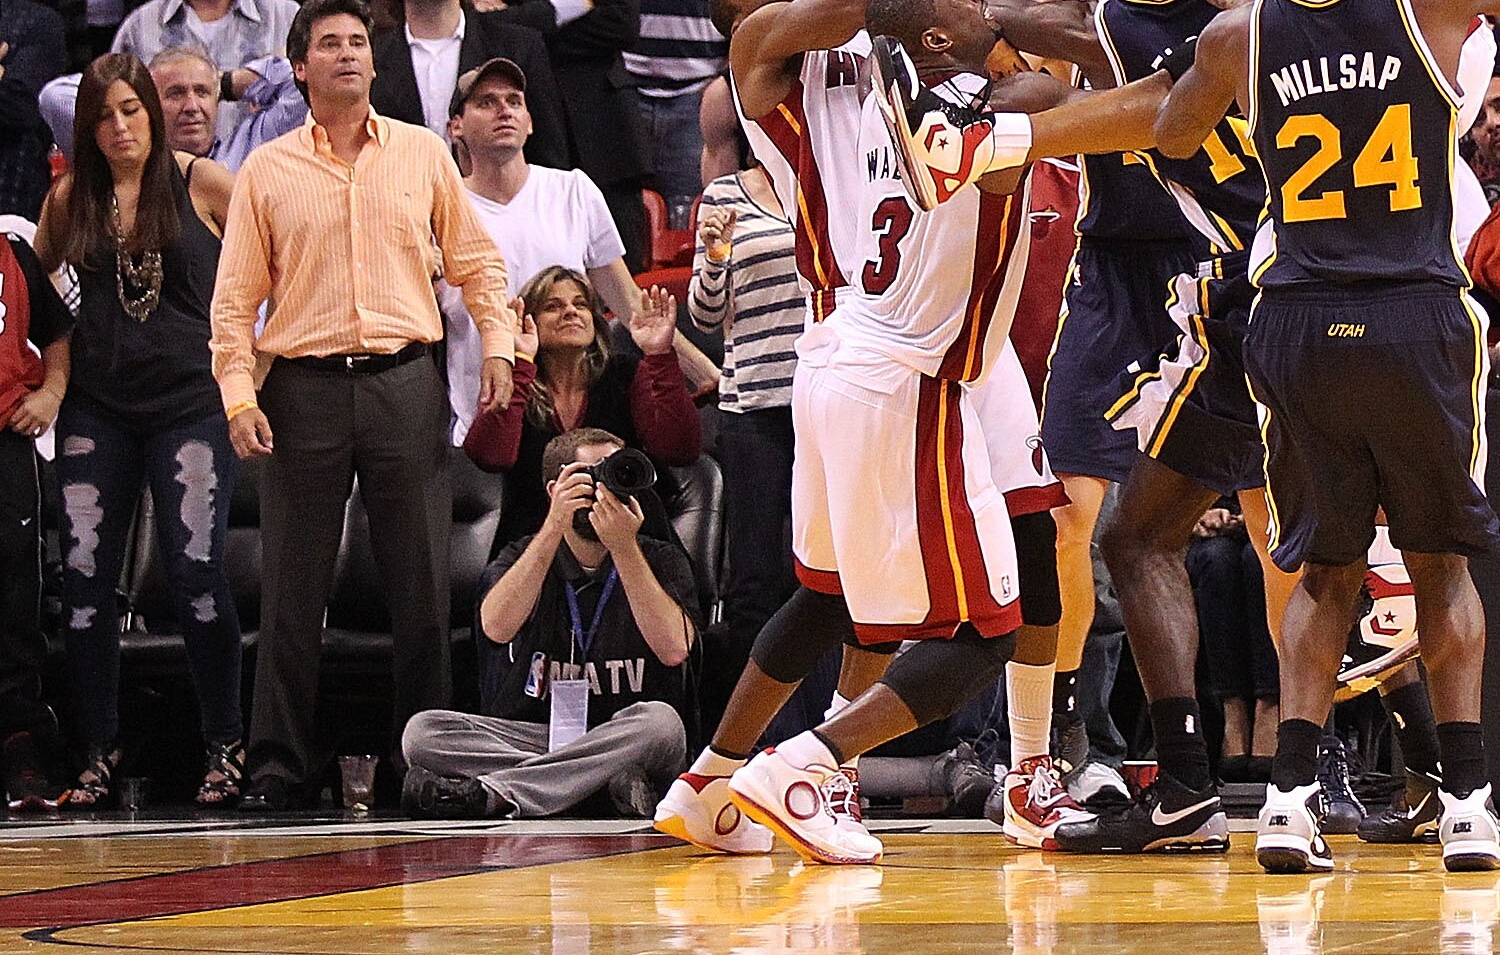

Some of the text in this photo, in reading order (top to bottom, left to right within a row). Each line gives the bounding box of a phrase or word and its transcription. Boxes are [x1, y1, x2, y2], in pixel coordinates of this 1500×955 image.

[1270, 52, 1402, 107] MILLSAP
[1276, 103, 1423, 224] 24
[861, 195, 914, 296] 3
[1327, 323, 1366, 337] UTAH
[605, 657, 645, 694] TV
